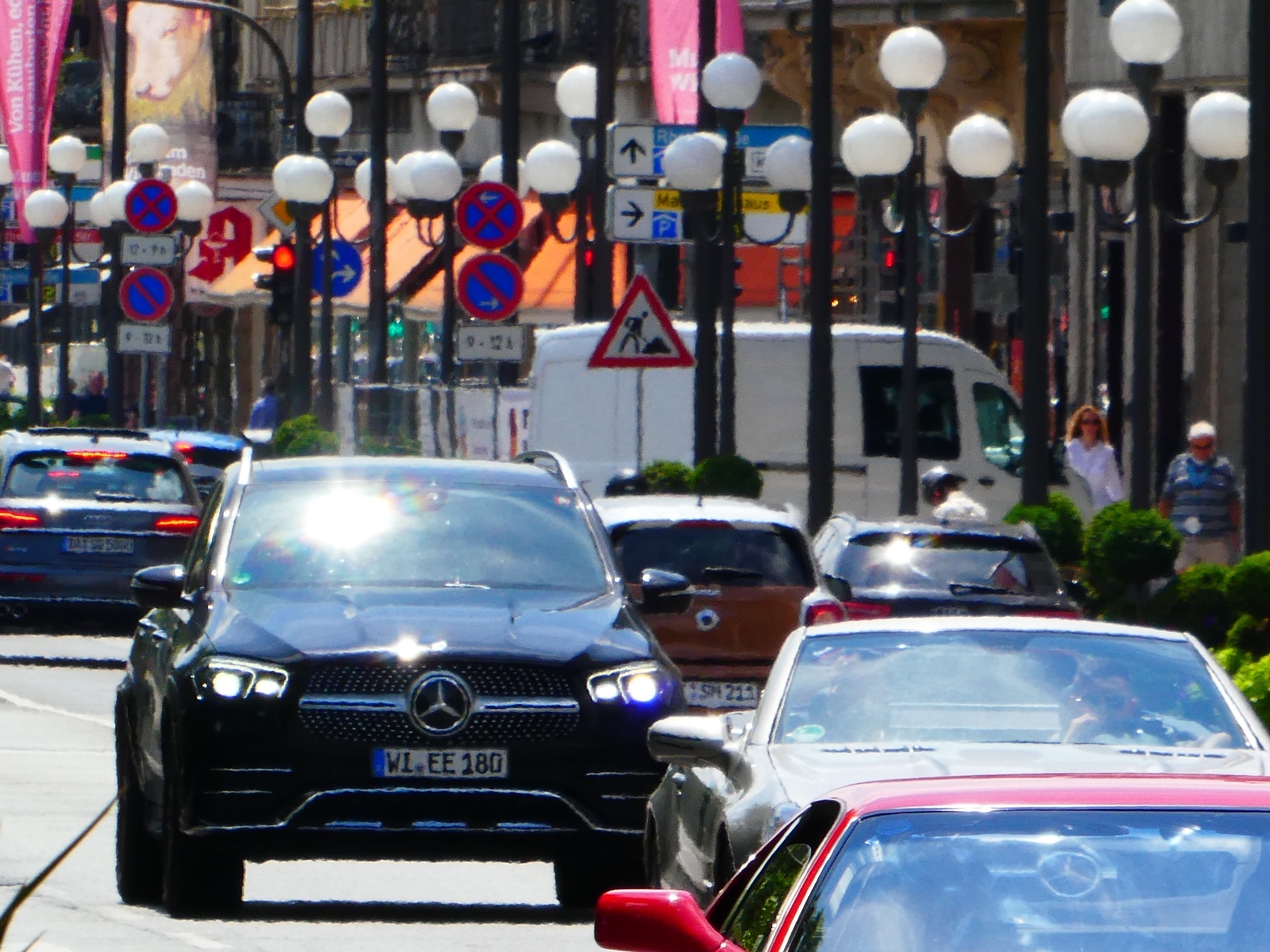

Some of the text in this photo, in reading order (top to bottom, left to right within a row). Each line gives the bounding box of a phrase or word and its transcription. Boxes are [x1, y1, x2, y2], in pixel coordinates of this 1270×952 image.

[9, 97, 24, 134] Von
[386, 752, 503, 775] WI EE 180
